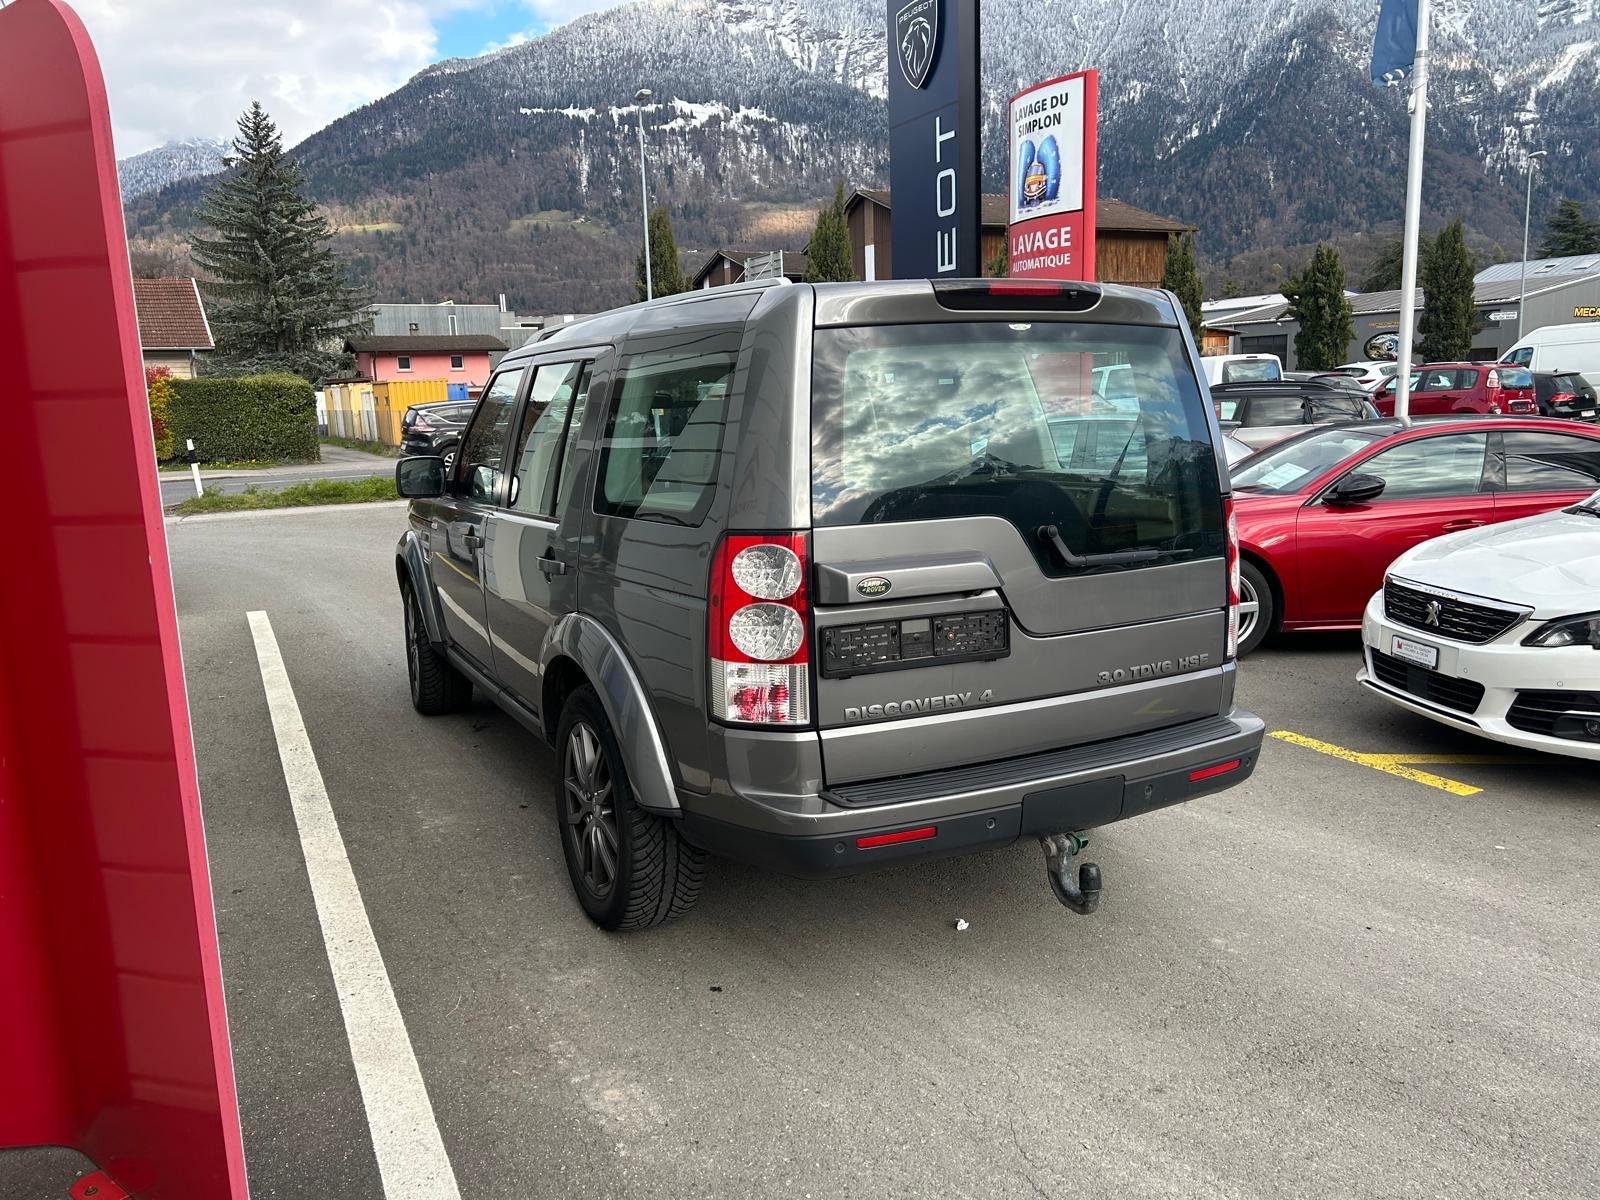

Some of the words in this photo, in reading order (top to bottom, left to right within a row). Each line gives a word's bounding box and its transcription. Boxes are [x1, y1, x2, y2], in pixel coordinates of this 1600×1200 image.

[898, 0, 933, 24] PEUGEOT
[1015, 98, 1048, 123] LAVAGE
[1050, 92, 1069, 110] DU
[1018, 112, 1062, 138] SIMPLON
[1012, 226, 1072, 256] LAVAGE
[1012, 253, 1071, 273] AUTOMATIQUE
[1097, 669, 1126, 685] 3.0
[1130, 660, 1173, 681] TDV6
[1178, 653, 1209, 671] HSE
[844, 692, 972, 721] DISCOVERY
[979, 689, 994, 703] 4
